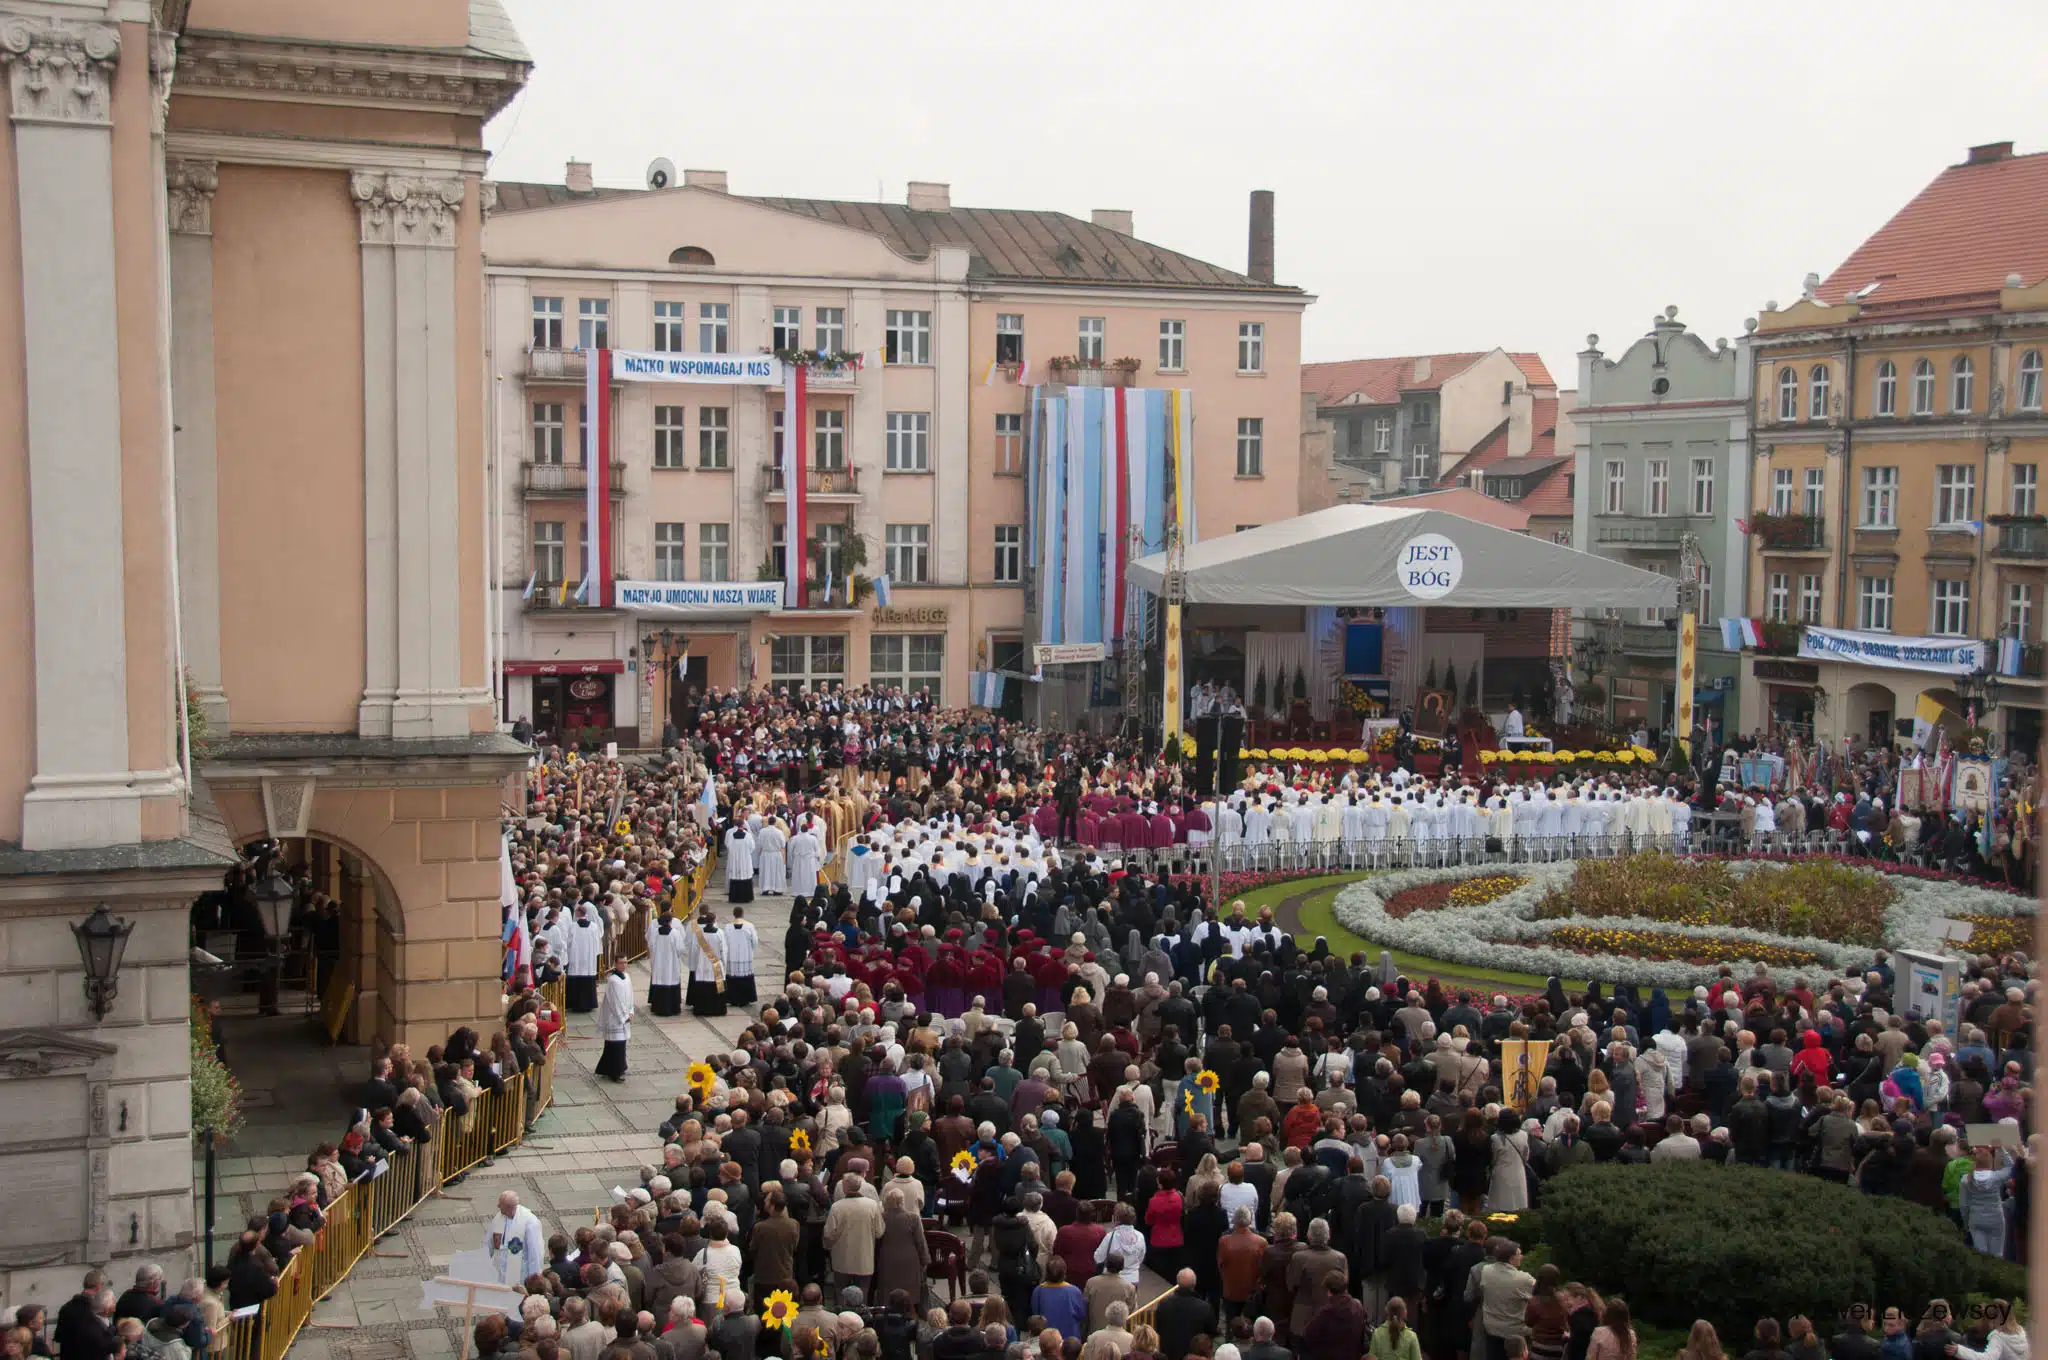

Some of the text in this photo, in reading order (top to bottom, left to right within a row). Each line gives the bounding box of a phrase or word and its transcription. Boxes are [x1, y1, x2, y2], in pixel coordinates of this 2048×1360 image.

[625, 358, 771, 377] MATKO WSPOMAGAJ NAS
[1404, 545, 1453, 565] JEST
[1408, 567, 1451, 587] BÓG
[623, 589, 777, 606] MARYJO UMOCNIJ NASZĄ WIARĘ
[1903, 645, 1955, 664] UCIEKAMY
[1958, 648, 1975, 667] SIĘ
